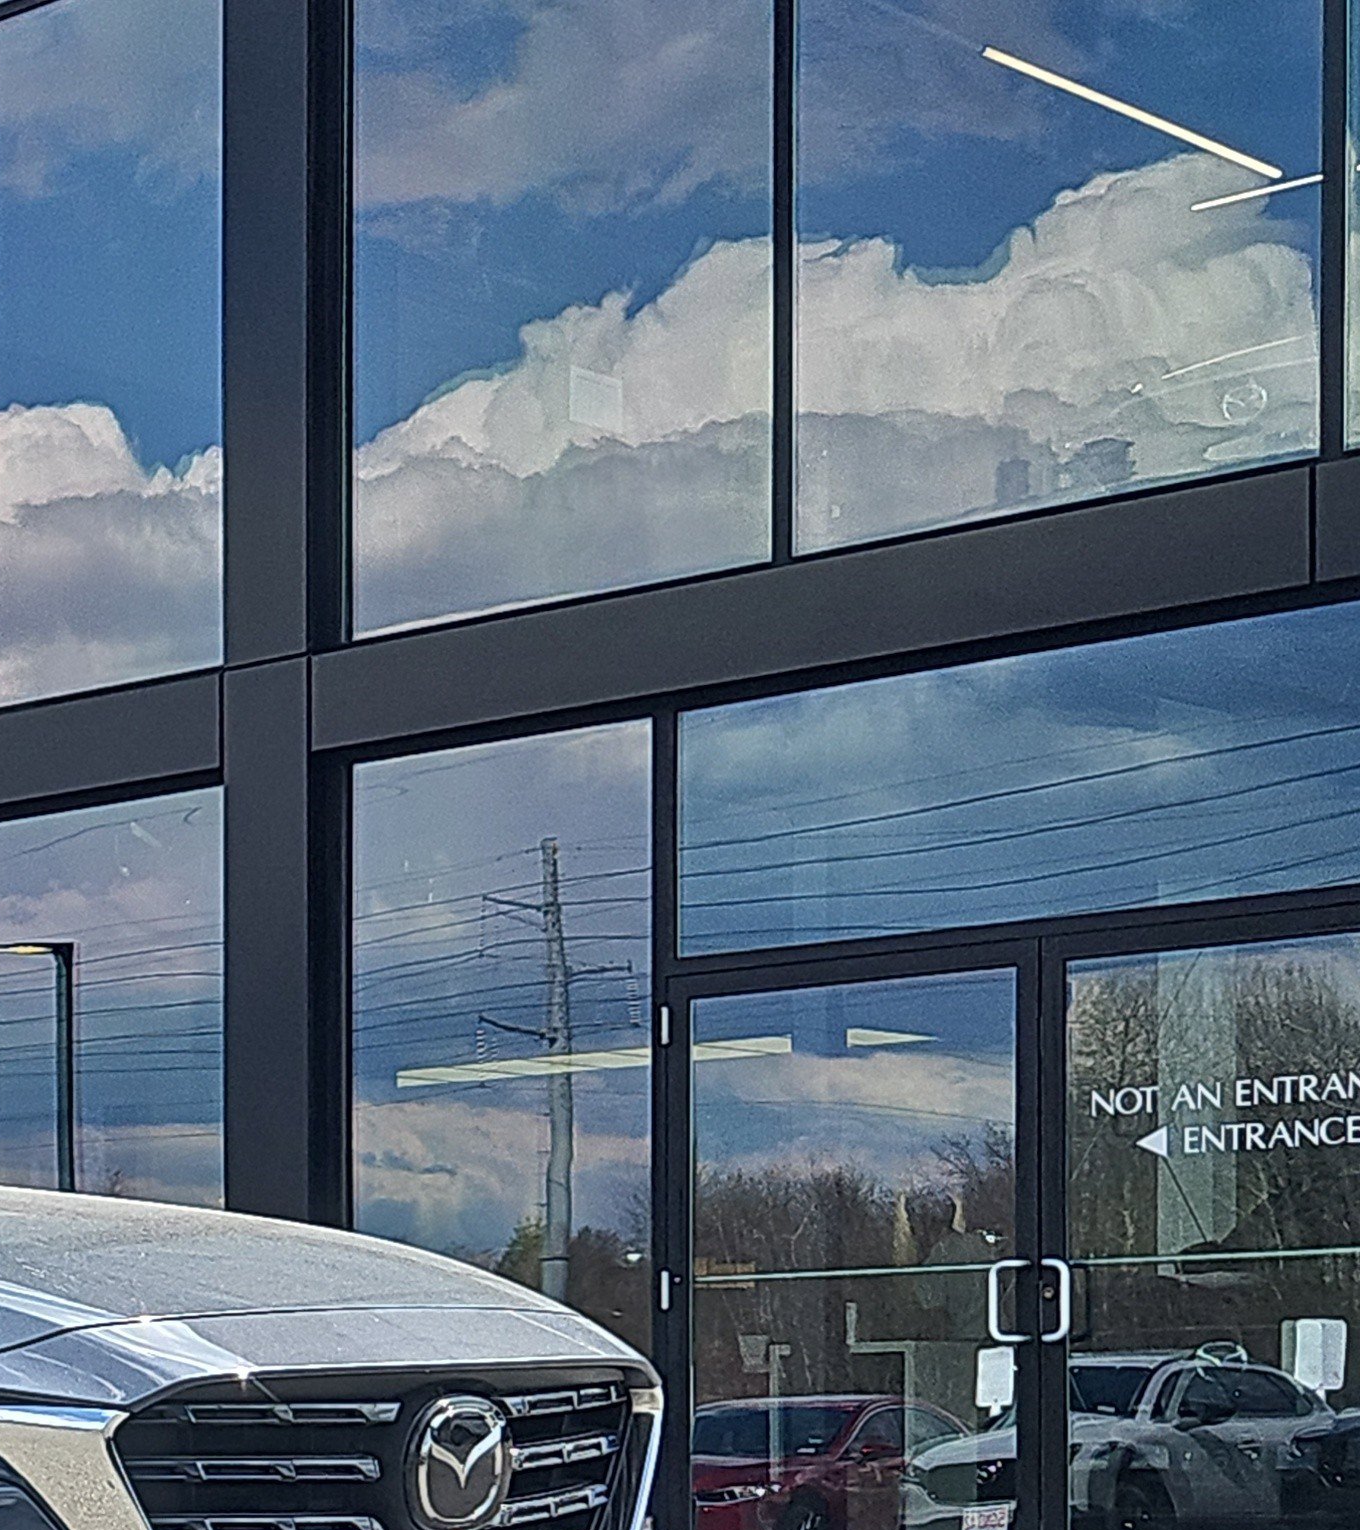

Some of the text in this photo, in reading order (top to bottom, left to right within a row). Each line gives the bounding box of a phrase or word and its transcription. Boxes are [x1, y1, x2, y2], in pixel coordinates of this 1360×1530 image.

[1091, 1086, 1158, 1117] NOT
[1171, 1082, 1222, 1111] AN
[1184, 1115, 1360, 1154] ENTRANCE
